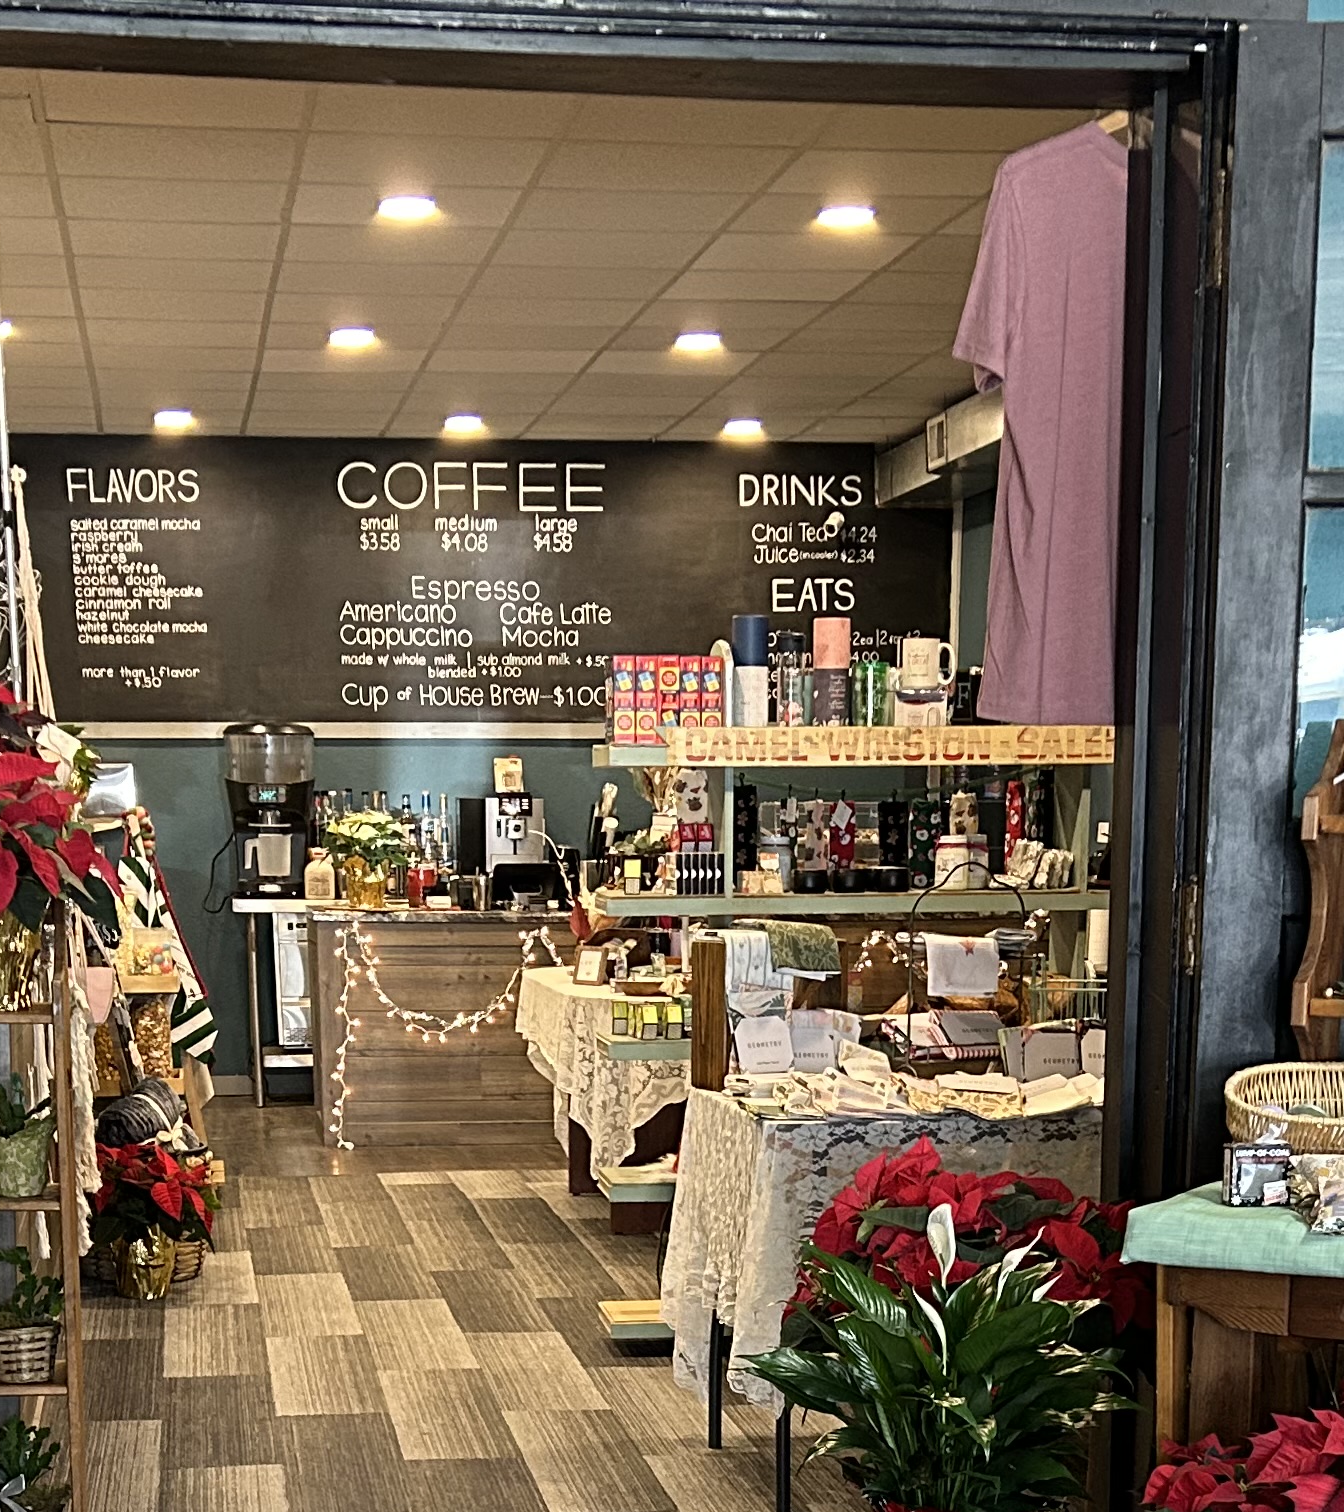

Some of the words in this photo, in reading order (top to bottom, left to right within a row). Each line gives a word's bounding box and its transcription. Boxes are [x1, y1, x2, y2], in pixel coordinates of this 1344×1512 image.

[66, 467, 200, 503] FLAVORS
[337, 461, 606, 512] COFFEE
[738, 473, 863, 507] DRINKS
[70, 518, 108, 531] salted
[110, 518, 159, 531] caramel
[161, 518, 201, 531] mocha
[360, 514, 399, 531] small
[434, 514, 498, 532] medium
[535, 513, 578, 536] large
[70, 530, 138, 543] raspberry
[751, 522, 793, 543] Chai
[798, 522, 829, 543] Tea
[71, 541, 99, 553] irish
[102, 541, 143, 553] cream
[441, 532, 489, 552] $4.08
[72, 552, 127, 564] s'mores
[753, 544, 799, 564] Juice
[840, 549, 876, 564] $2.34
[72, 563, 113, 575] butter
[117, 562, 159, 574] toffee
[74, 574, 119, 586] cookie
[125, 573, 167, 588] dough
[74, 586, 127, 598] caramel
[132, 585, 203, 598] cheesecake
[411, 576, 541, 605] Espresso
[771, 577, 856, 613] EATS
[75, 598, 142, 610] cinnamon
[148, 597, 171, 610] roll
[75, 610, 130, 621] hazelnut
[339, 600, 456, 624] Americano
[499, 602, 554, 625] Cafe
[559, 602, 612, 625] Latte
[77, 620, 108, 633] white
[112, 621, 170, 633] chocolate
[172, 621, 208, 633] mocha
[78, 633, 155, 645] cheesecake
[340, 624, 473, 650] Cappuccino
[502, 626, 579, 648] Mocha
[340, 652, 374, 665] made
[377, 653, 390, 667] w/
[392, 653, 426, 666] whole
[434, 653, 457, 666] milk
[476, 653, 499, 666] sub
[501, 653, 543, 666] almond
[547, 652, 571, 666] milk
[82, 667, 114, 678] more
[119, 666, 146, 678] than
[158, 666, 201, 678] flavor
[427, 665, 477, 678] blended
[341, 682, 389, 712] Cup
[396, 686, 413, 701] of
[685, 727, 809, 762] CAMEL
[1016, 726, 1115, 760] SALE
